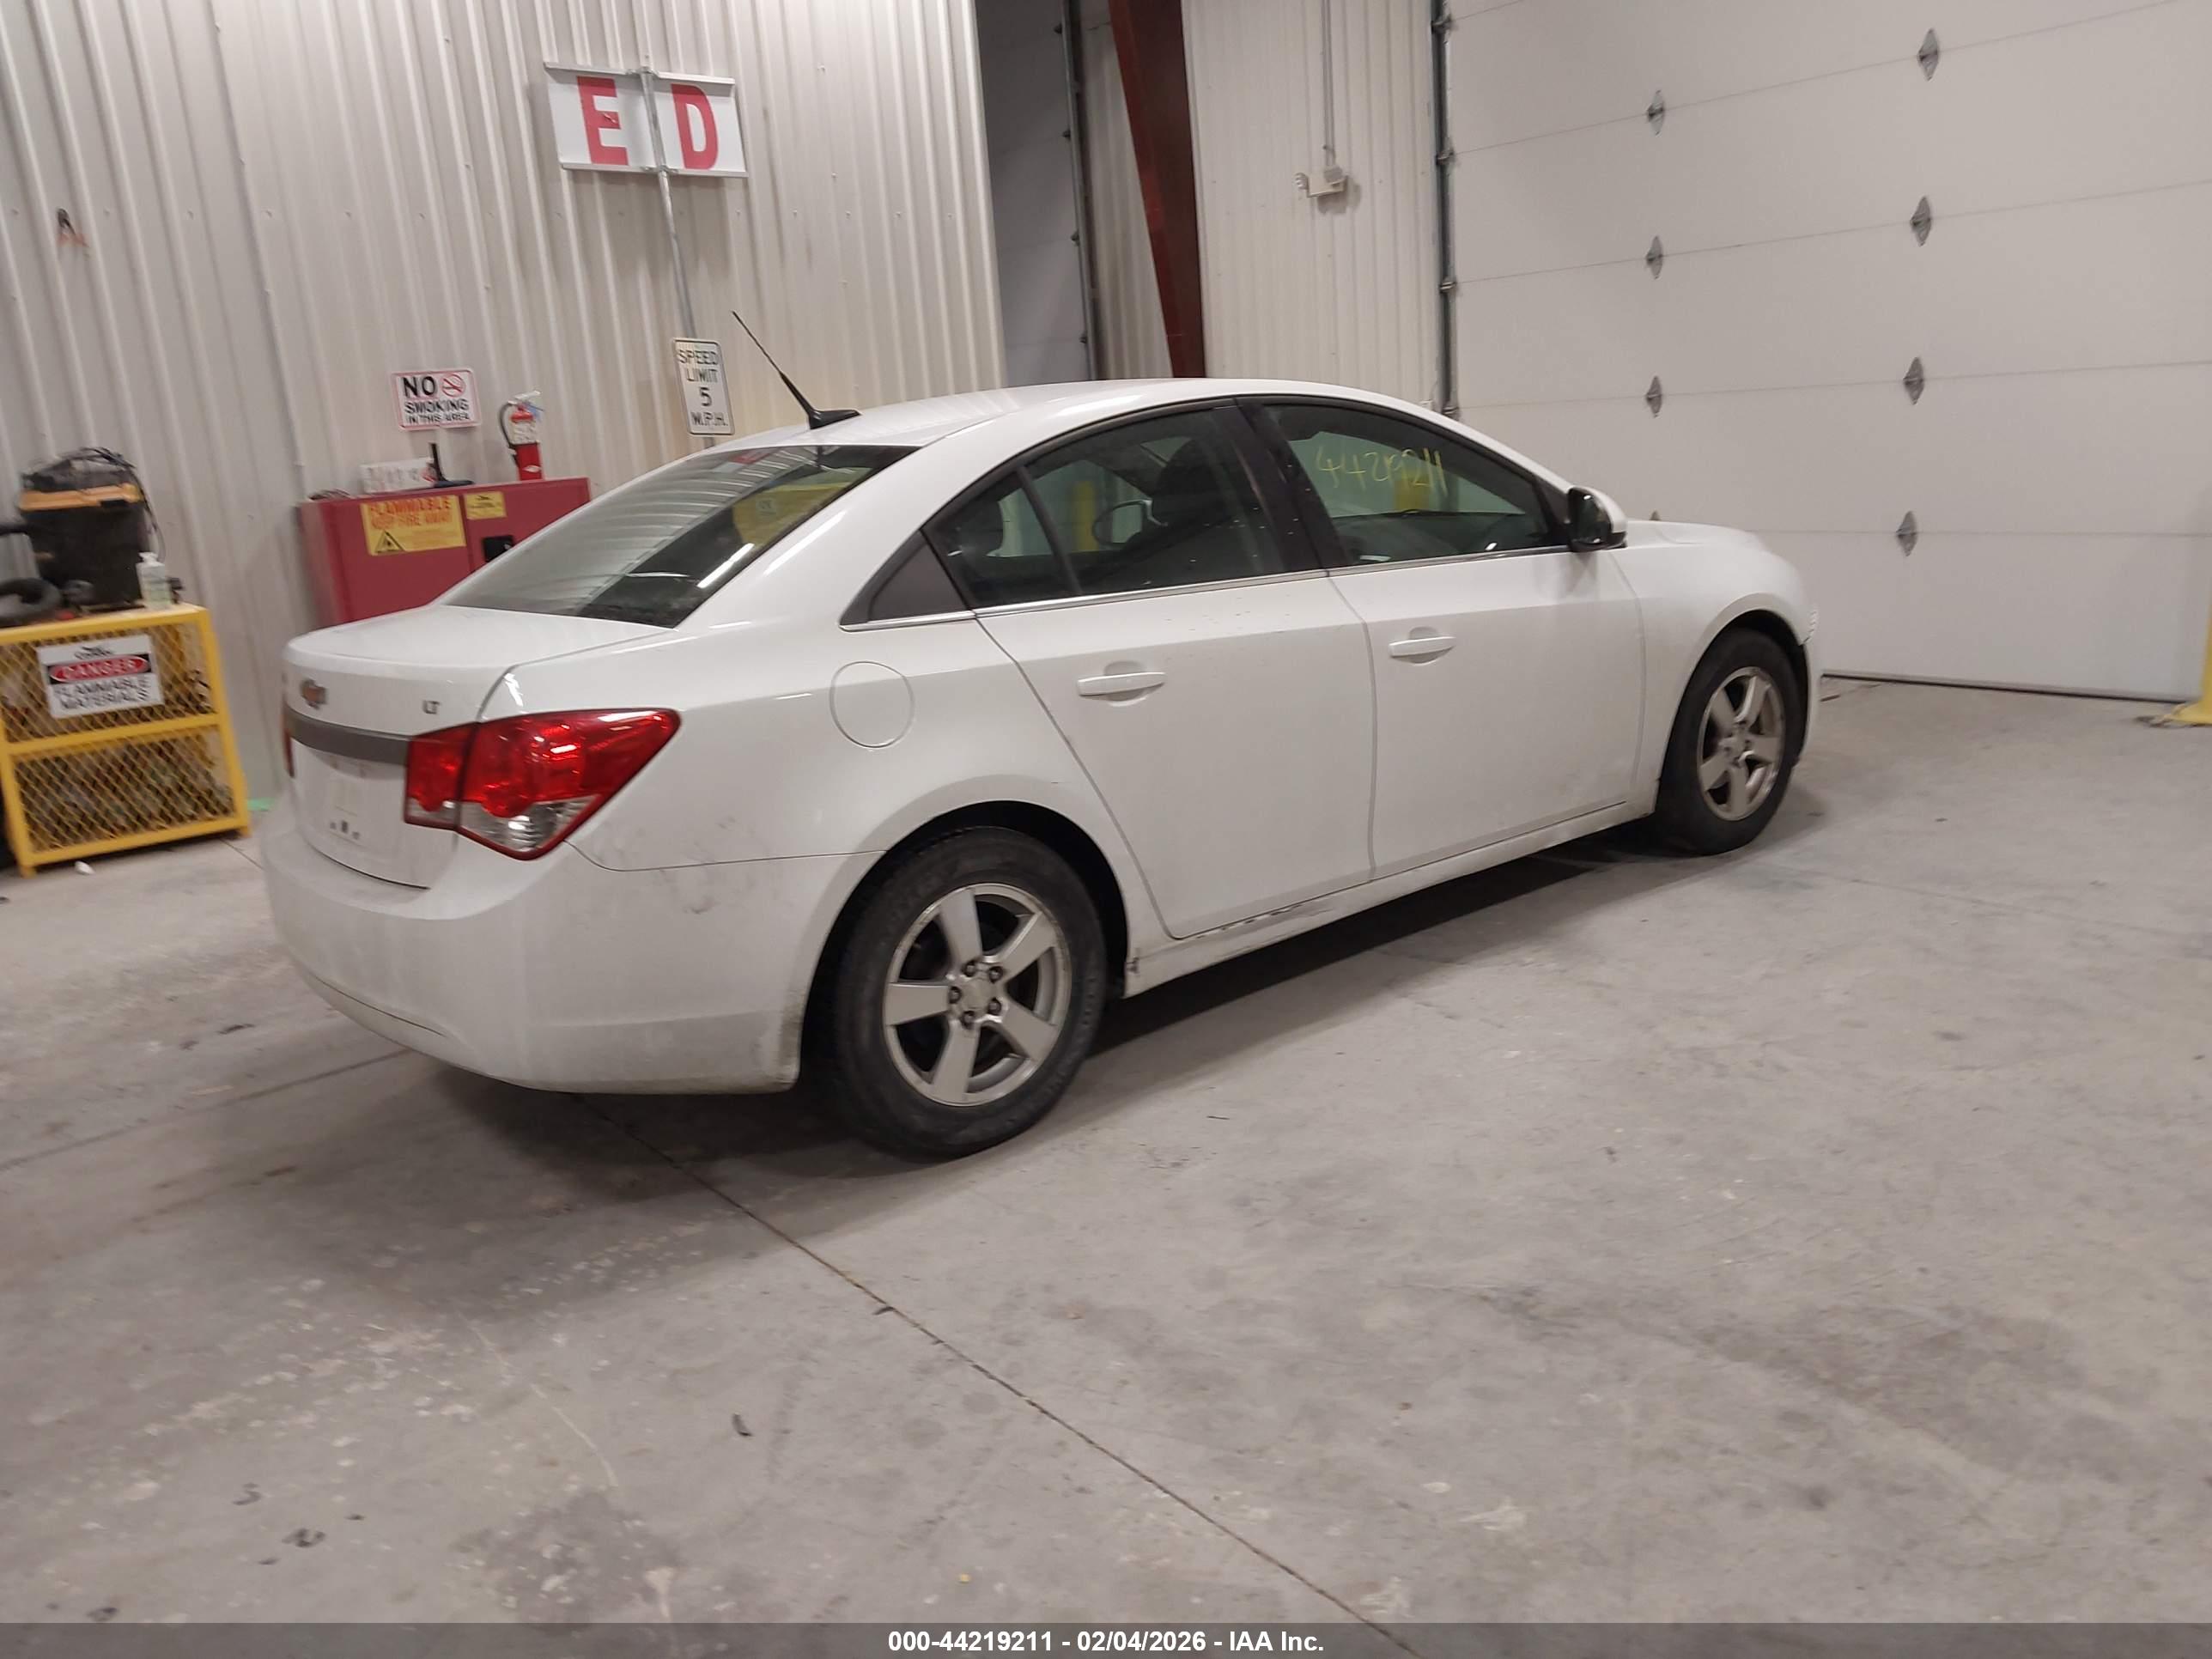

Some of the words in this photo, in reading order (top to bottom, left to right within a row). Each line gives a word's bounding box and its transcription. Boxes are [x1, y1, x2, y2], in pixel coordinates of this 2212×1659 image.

[577, 76, 629, 166] E
[671, 83, 719, 170] D
[677, 349, 719, 365] SPEED
[686, 368, 719, 383] LIMIT
[402, 376, 437, 397] NO
[699, 386, 713, 406] 5
[404, 398, 470, 414] SMOKING
[422, 700, 441, 714] LT
